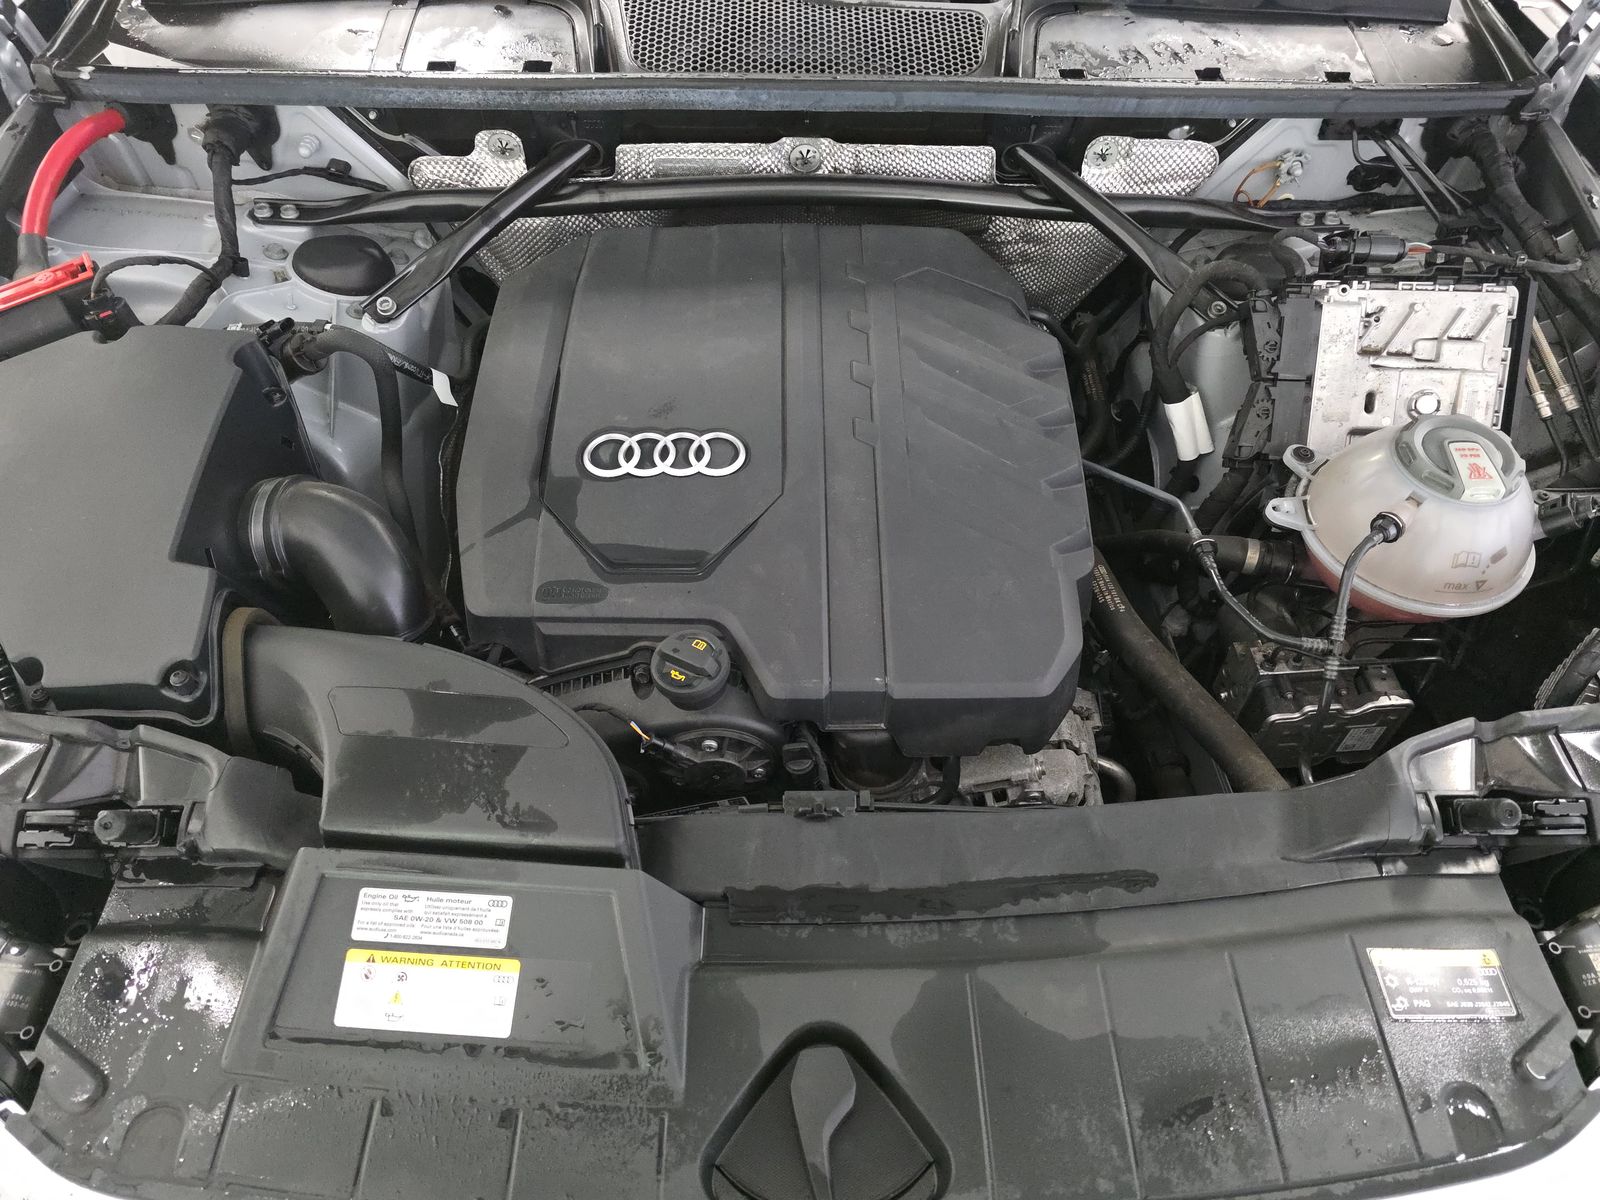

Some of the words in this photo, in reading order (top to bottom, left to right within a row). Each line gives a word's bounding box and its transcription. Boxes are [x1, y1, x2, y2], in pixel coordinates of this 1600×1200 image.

[1444, 582, 1469, 591] max
[363, 892, 387, 900] Engine
[380, 956, 434, 966] WARNING
[440, 959, 502, 970] ATTENTION
